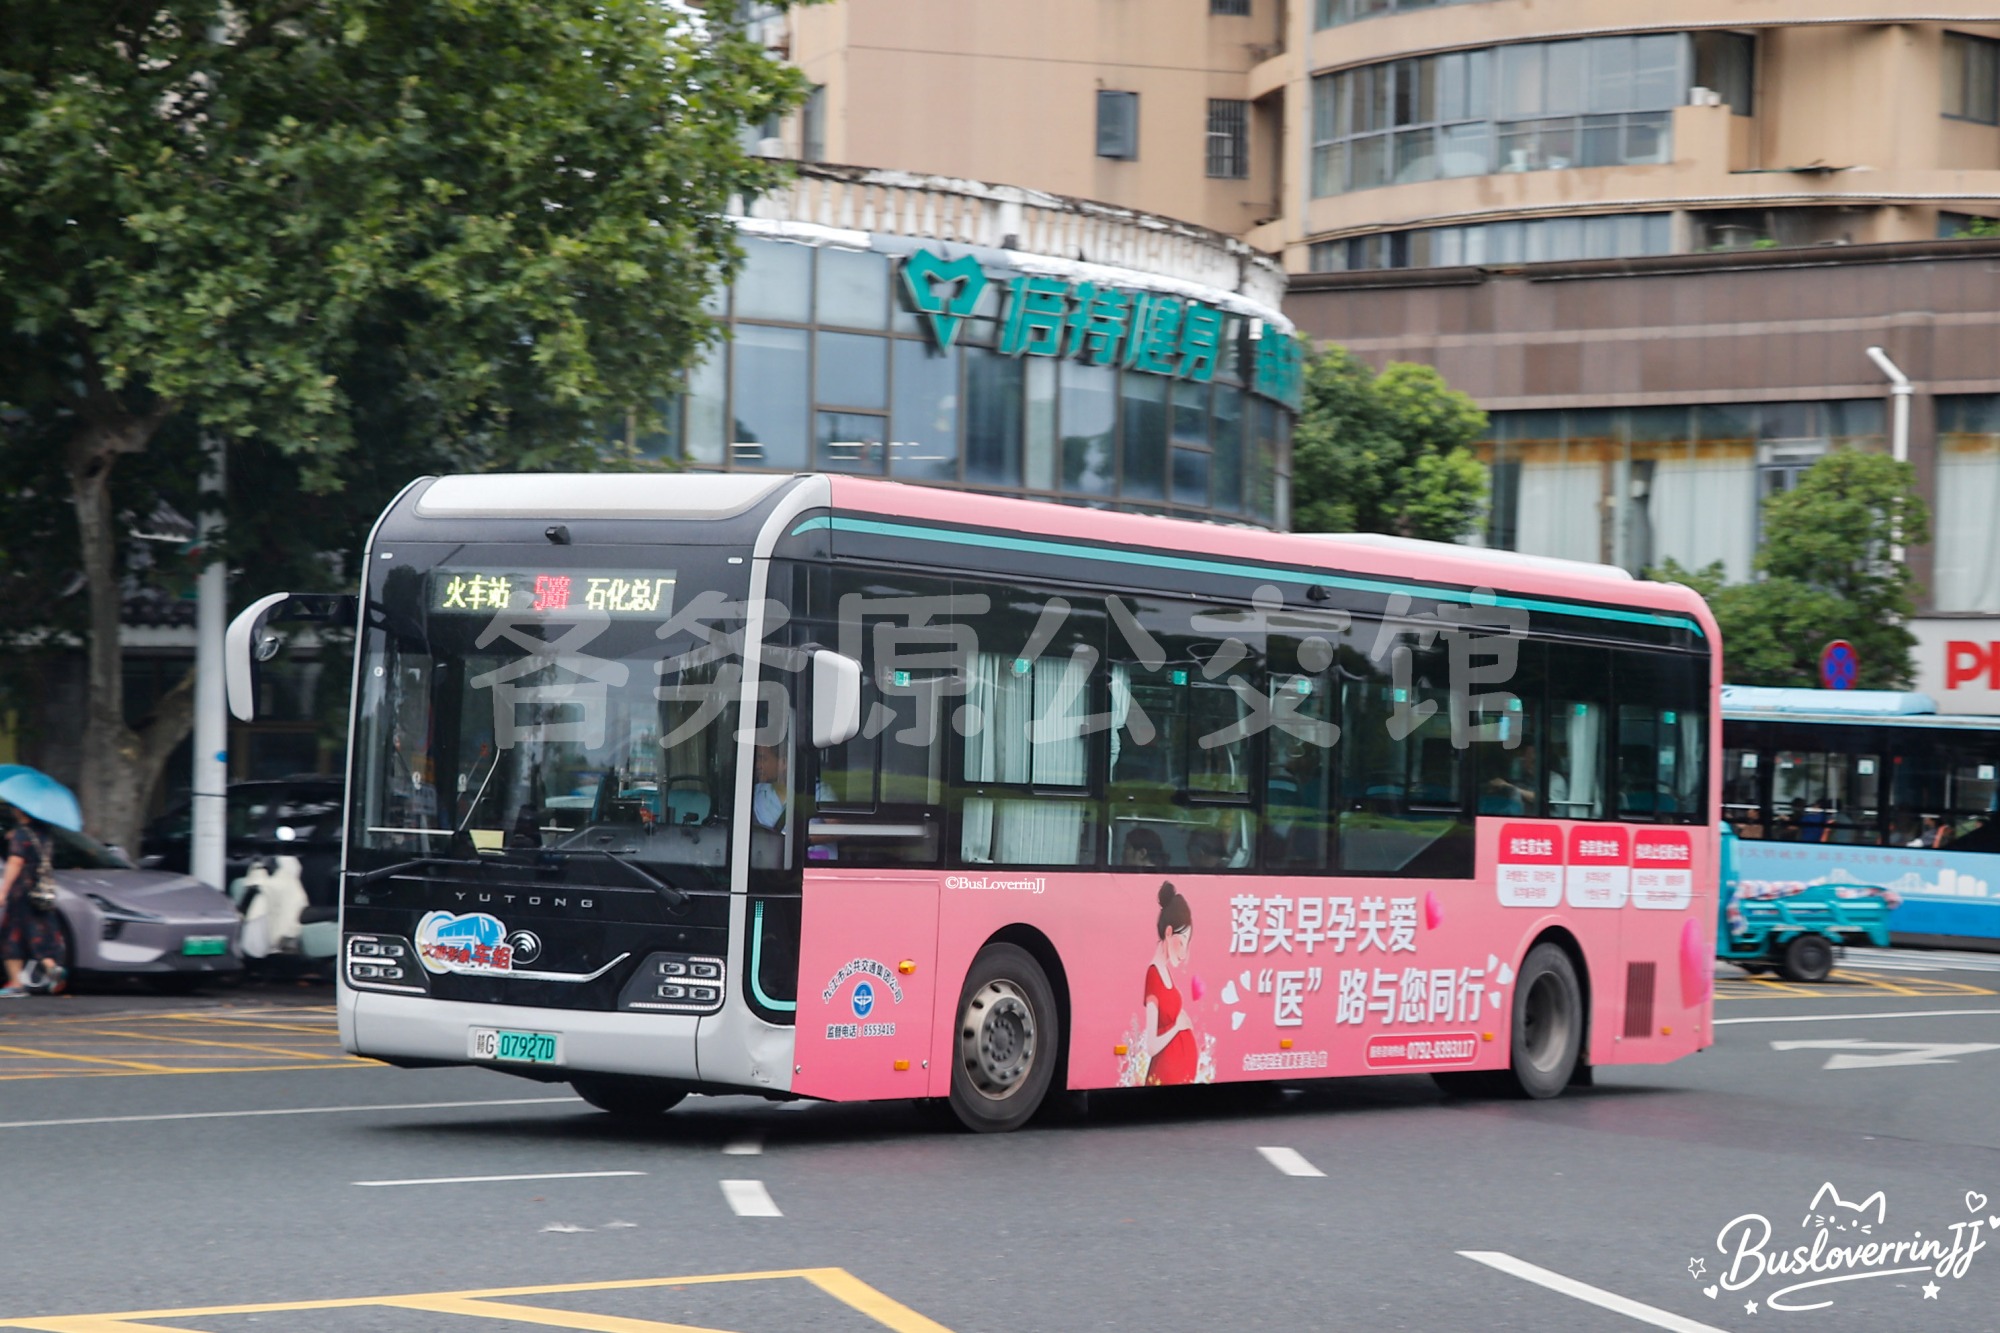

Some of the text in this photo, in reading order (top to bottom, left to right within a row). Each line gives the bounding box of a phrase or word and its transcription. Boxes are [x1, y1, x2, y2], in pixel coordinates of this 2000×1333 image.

[443, 574, 512, 610] 火车站
[585, 578, 677, 611] 石化总厂
[455, 892, 593, 908] YUTONG
[1229, 893, 1418, 954] 落实早孕关爱
